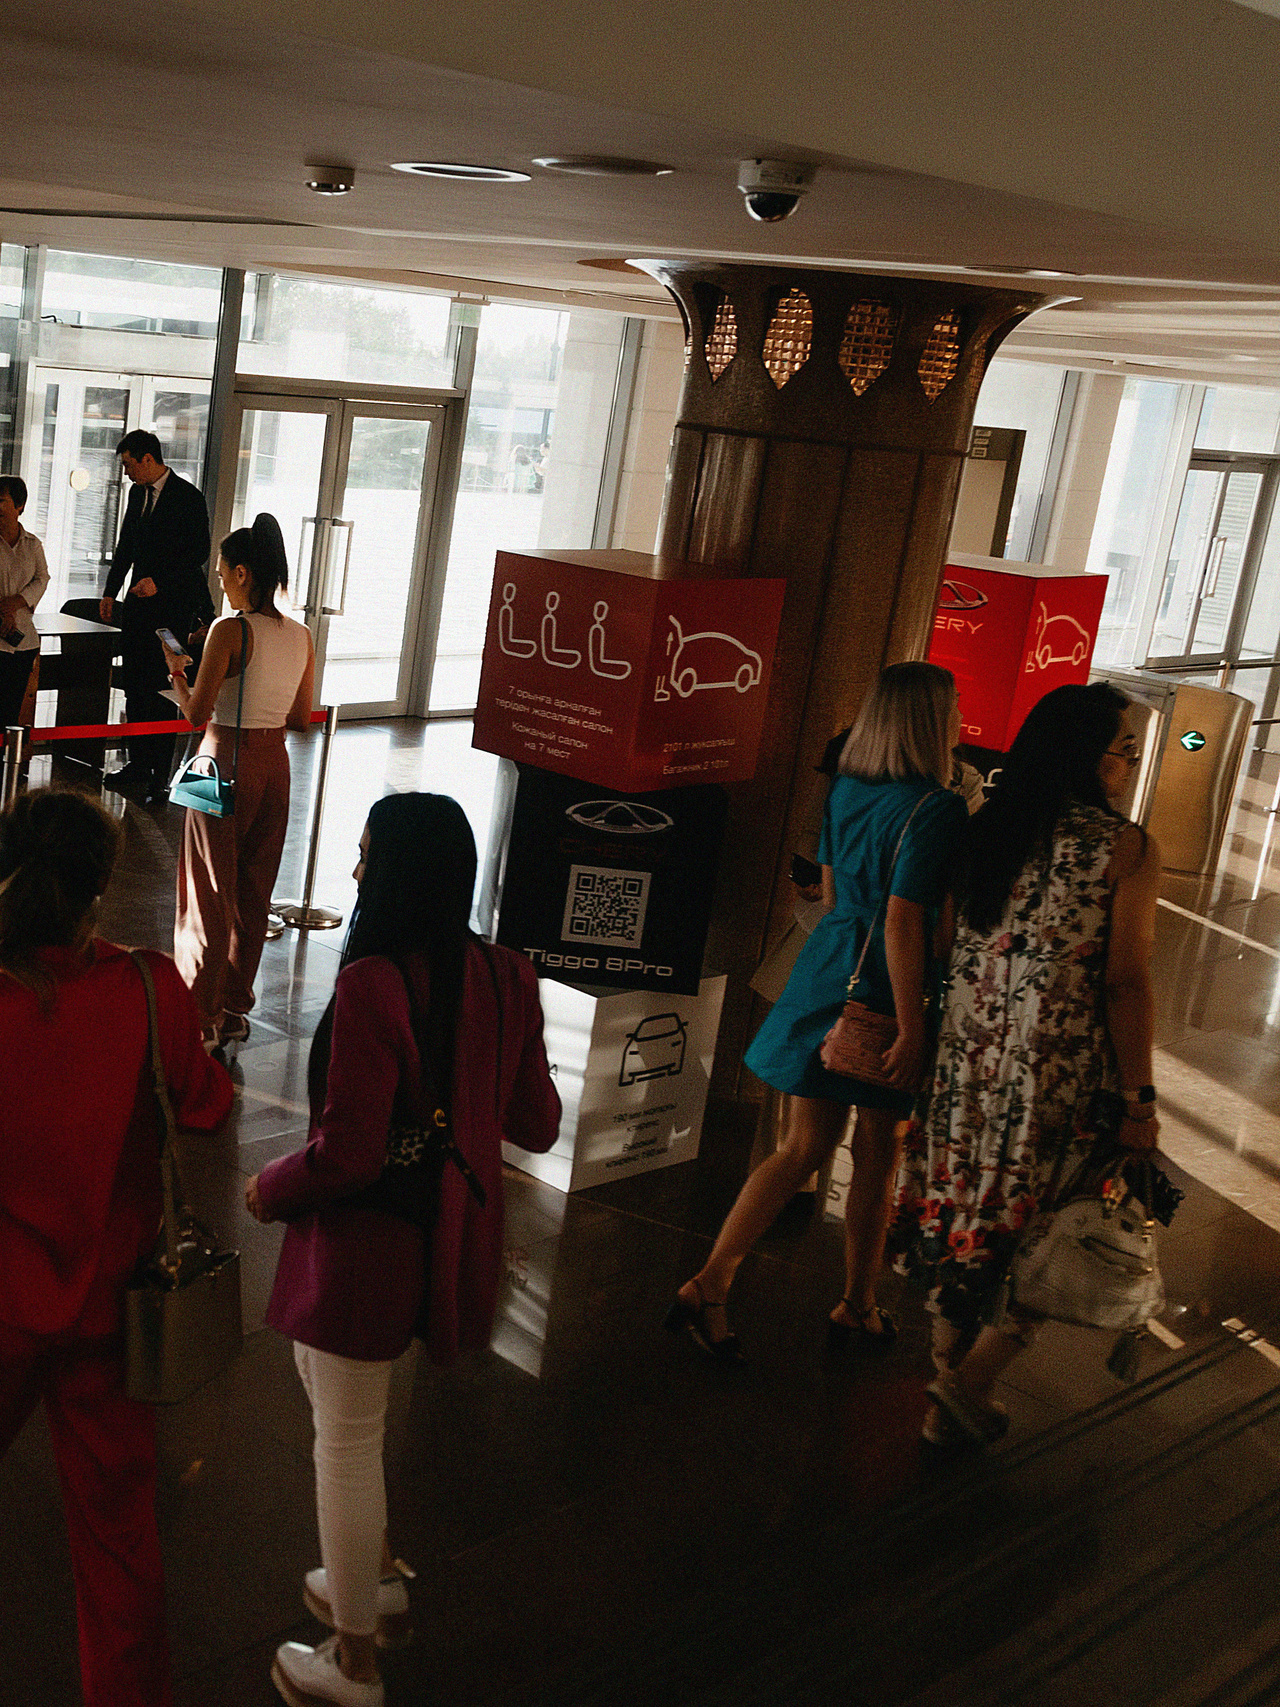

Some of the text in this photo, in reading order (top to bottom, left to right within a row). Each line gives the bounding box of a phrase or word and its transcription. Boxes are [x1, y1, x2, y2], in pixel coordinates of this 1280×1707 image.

[934, 615, 983, 635] ERY
[508, 685, 516, 694] 7
[554, 698, 602, 717] арналған
[531, 707, 581, 727] жасалған
[582, 719, 614, 735] салон
[511, 721, 589, 750] Кожаный салон
[524, 741, 571, 760] на 7 мест
[523, 947, 674, 977] Tiggo 8Pro
